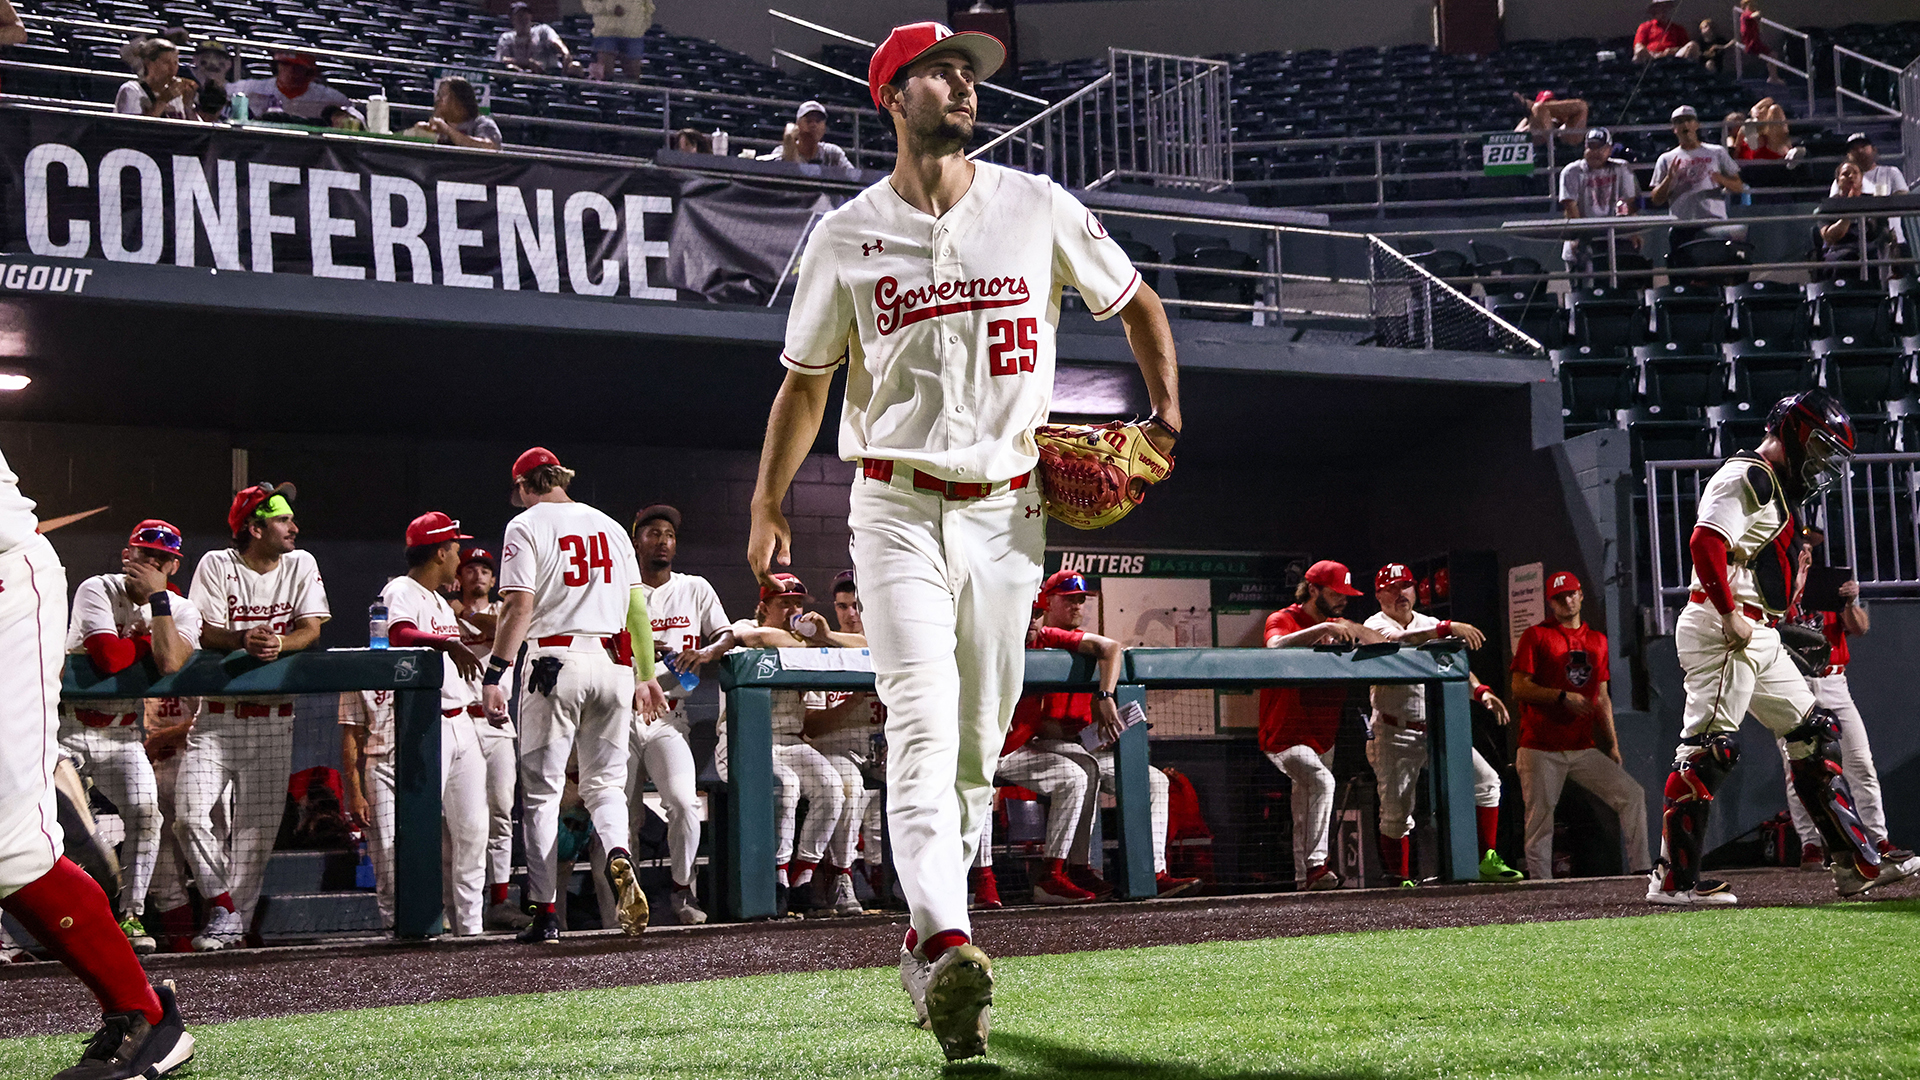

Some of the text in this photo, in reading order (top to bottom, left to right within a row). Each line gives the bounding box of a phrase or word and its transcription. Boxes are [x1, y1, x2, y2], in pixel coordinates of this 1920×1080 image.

[1488, 146, 1529, 163] 203
[24, 142, 678, 301] CONFERENCE
[0, 263, 93, 293] GOUT
[875, 276, 1030, 336] Governors
[988, 317, 1038, 377] 25
[1138, 452, 1166, 479] Wilson
[558, 531, 613, 587] 34
[1061, 552, 1145, 574] HATTERS
[227, 594, 295, 622] Governors
[650, 616, 692, 632] ernors
